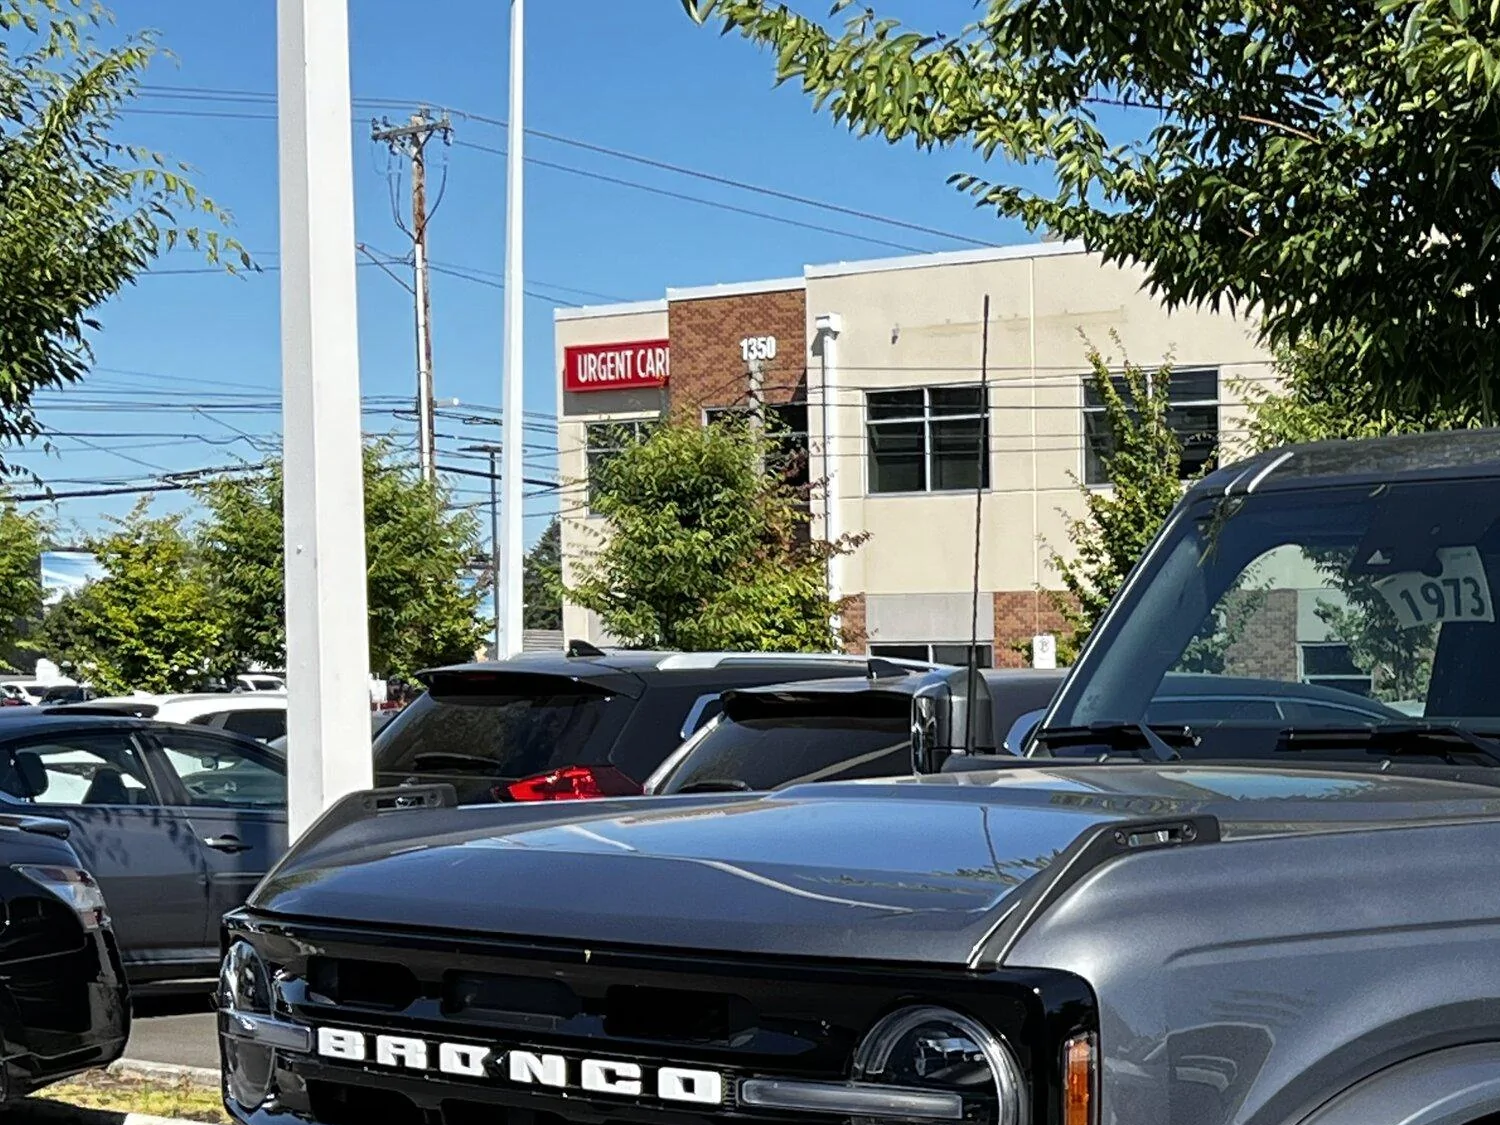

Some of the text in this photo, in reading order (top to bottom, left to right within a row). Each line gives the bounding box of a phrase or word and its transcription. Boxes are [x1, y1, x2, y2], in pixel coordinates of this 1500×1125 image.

[577, 349, 634, 383] URGENT
[739, 336, 776, 361] 1350
[1399, 576, 1485, 621] 1973
[317, 1026, 723, 1104] BRONCO
